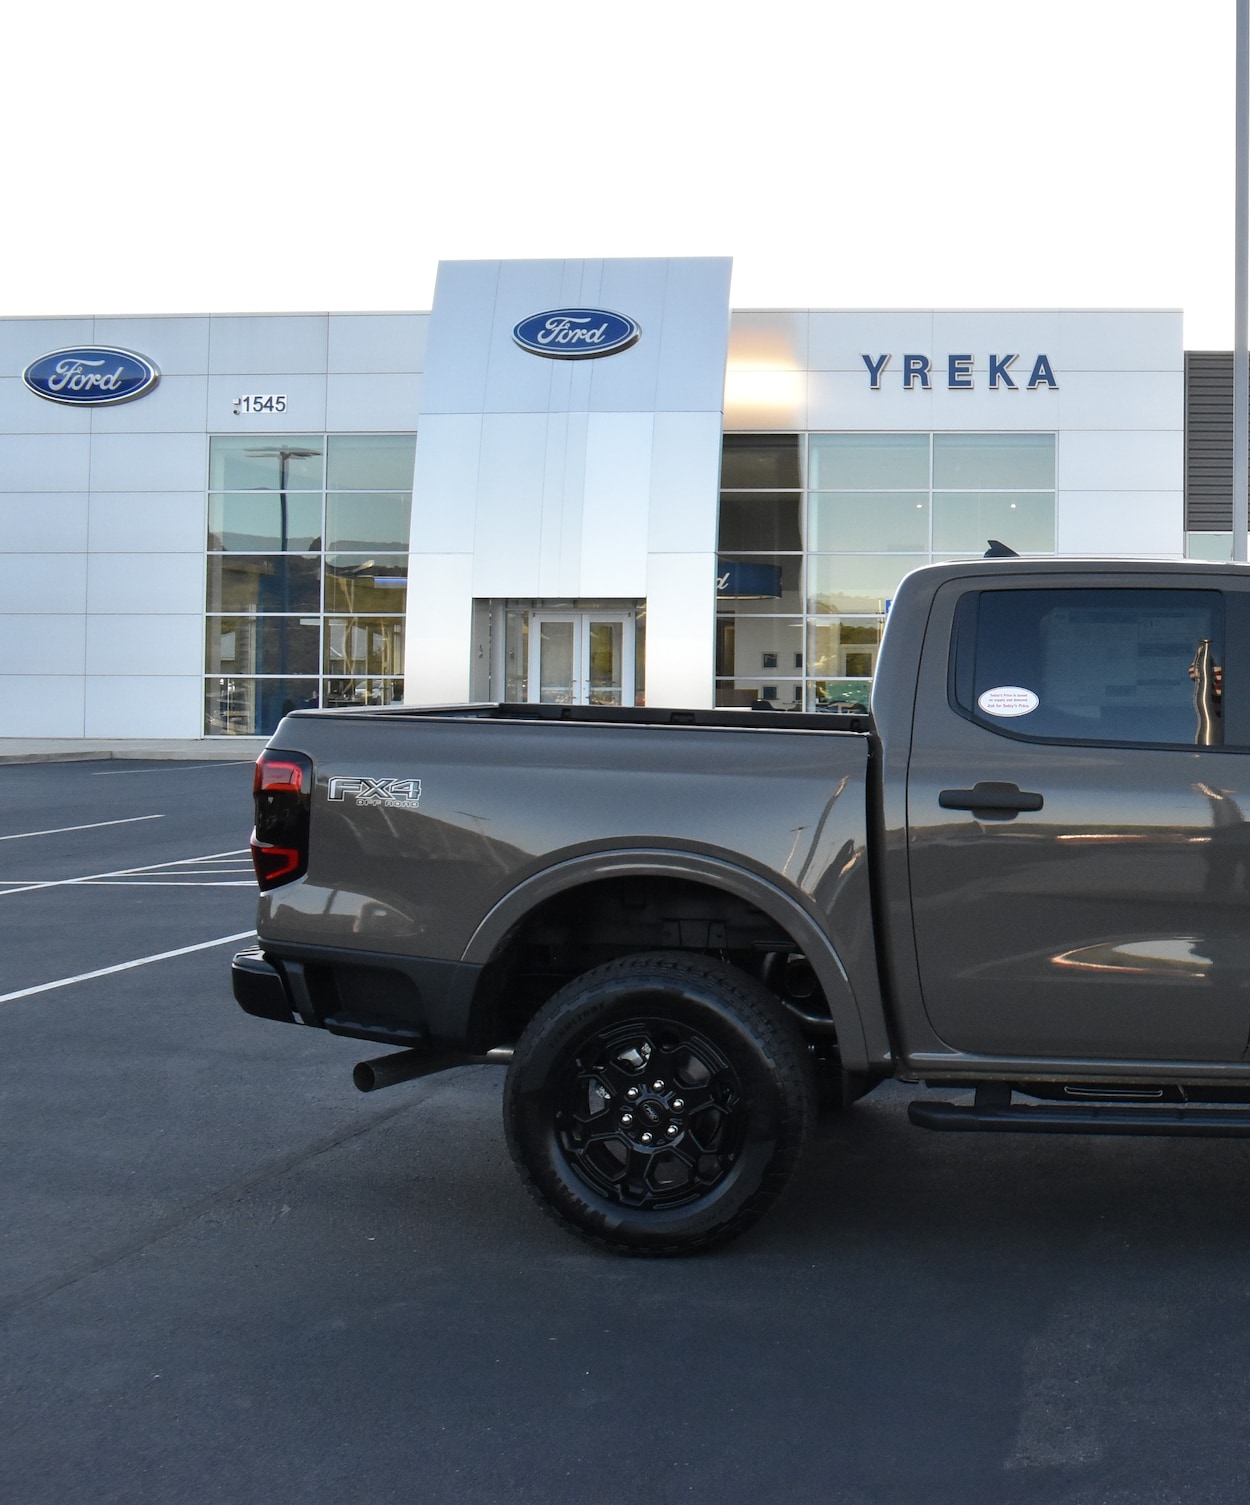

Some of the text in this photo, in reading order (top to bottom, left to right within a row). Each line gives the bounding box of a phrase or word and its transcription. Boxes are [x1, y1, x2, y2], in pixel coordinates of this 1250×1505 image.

[537, 316, 609, 344] Ford
[48, 358, 125, 391] Ford
[861, 353, 1060, 390] YREKA
[243, 395, 286, 412] 1545
[328, 776, 421, 801] FX4
[356, 799, 419, 808] OFF ROAD
